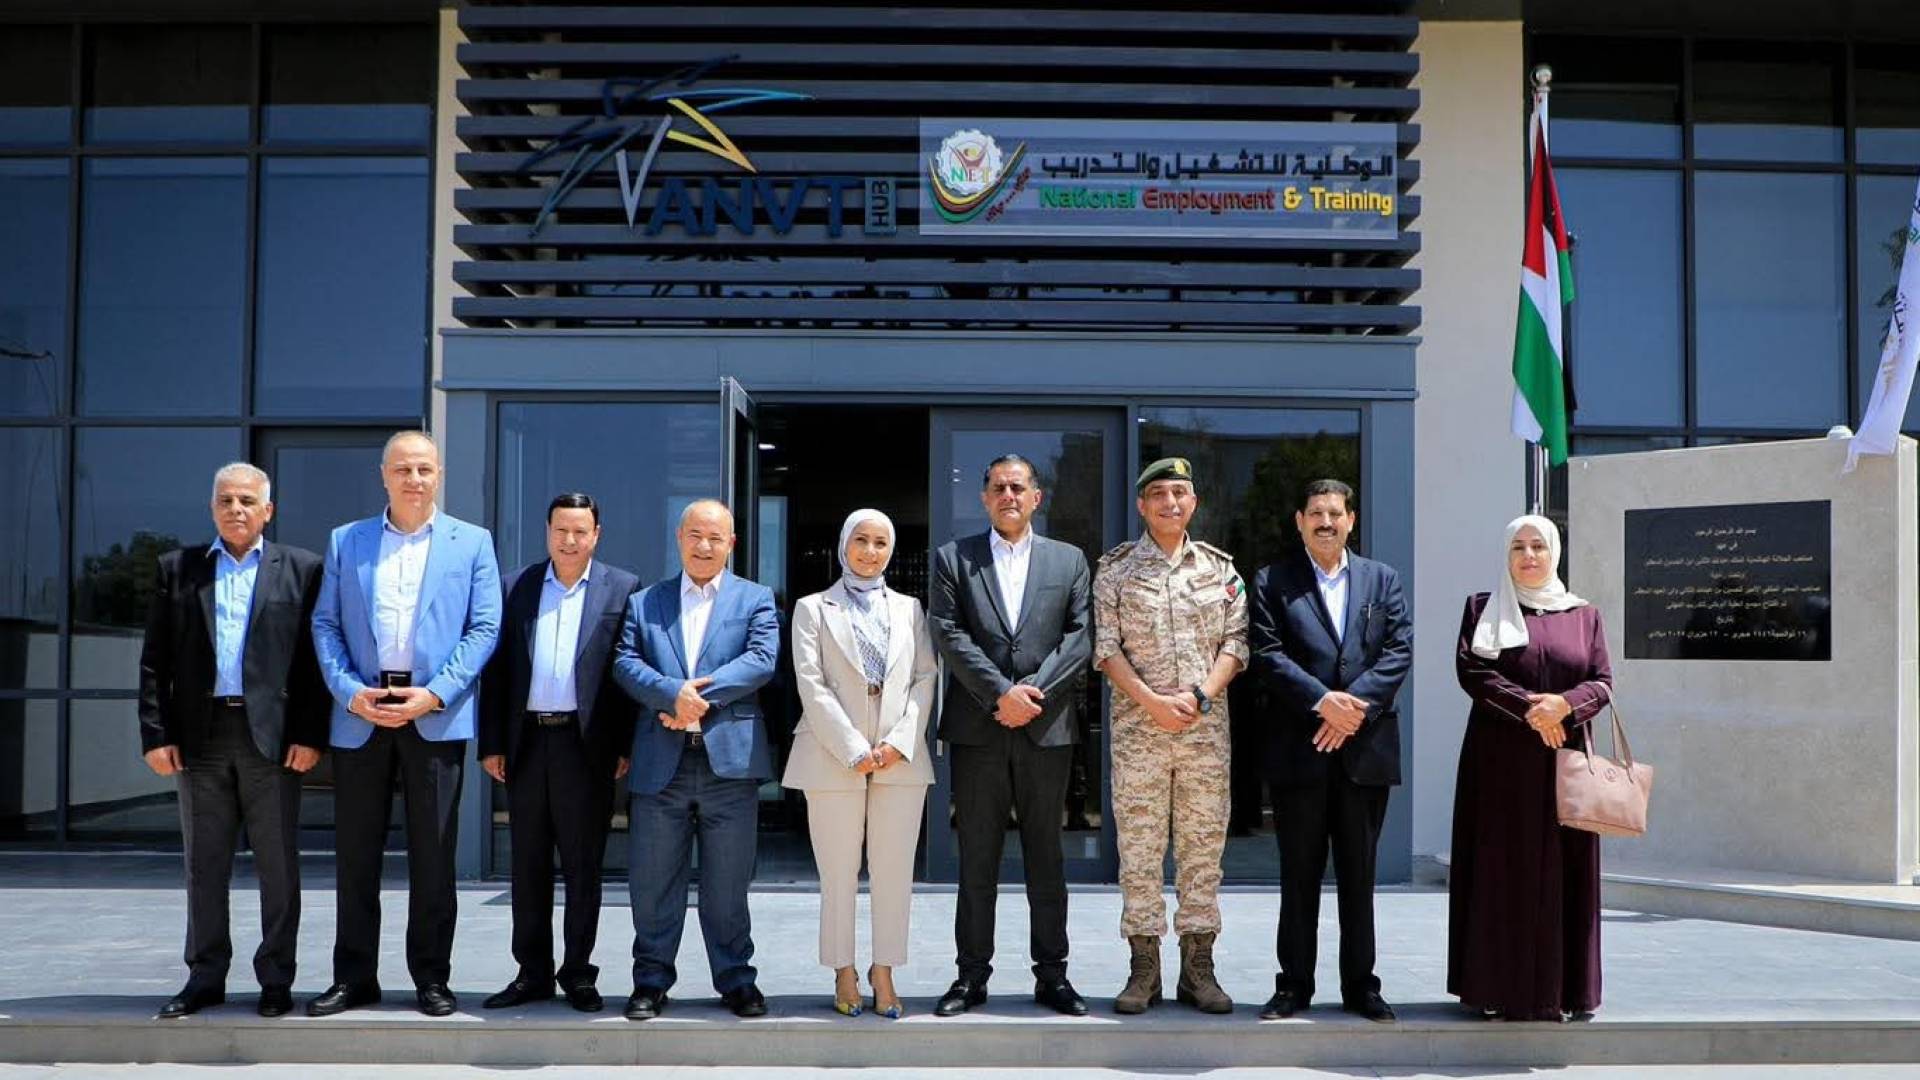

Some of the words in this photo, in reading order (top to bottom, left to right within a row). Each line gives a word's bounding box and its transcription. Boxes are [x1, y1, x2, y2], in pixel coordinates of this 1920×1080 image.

[1040, 151, 1160, 180] والتدريب
[1165, 148, 1287, 180] للتشغيل
[1292, 153, 1393, 181] الوطنية
[871, 180, 890, 227] HUB
[1039, 185, 1137, 209] National
[1142, 187, 1275, 214] Employment
[1283, 186, 1302, 210] &
[1309, 186, 1393, 215] Training
